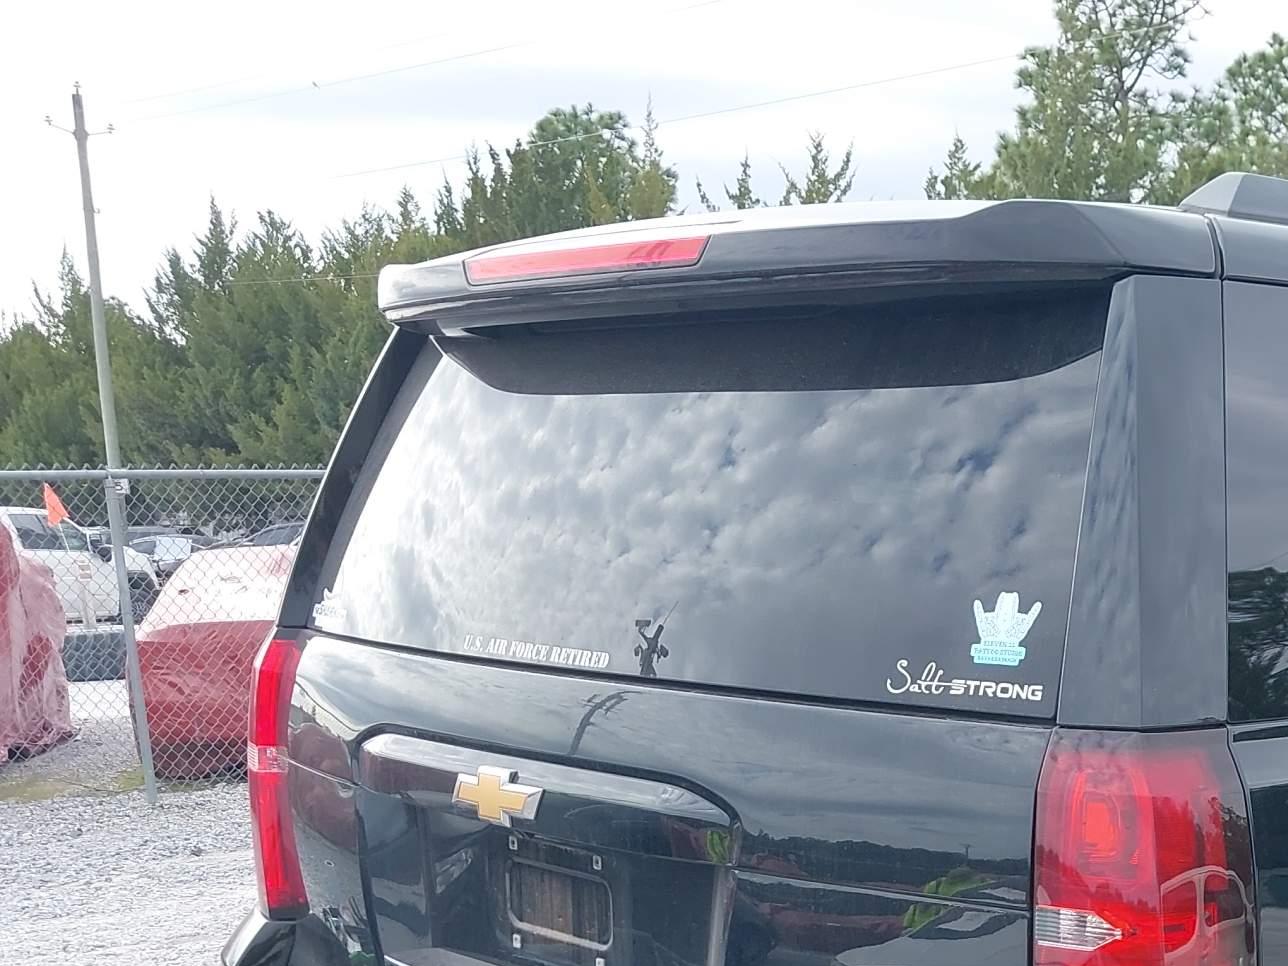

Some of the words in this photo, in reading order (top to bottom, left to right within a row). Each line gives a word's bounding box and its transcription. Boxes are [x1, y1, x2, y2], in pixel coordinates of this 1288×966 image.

[464, 634, 483, 652] U.S.
[485, 638, 508, 656] AIR
[508, 641, 550, 662] FORCE
[550, 646, 610, 668] RETIRED
[886, 659, 944, 694] Salt
[950, 679, 1043, 701] STRONG
